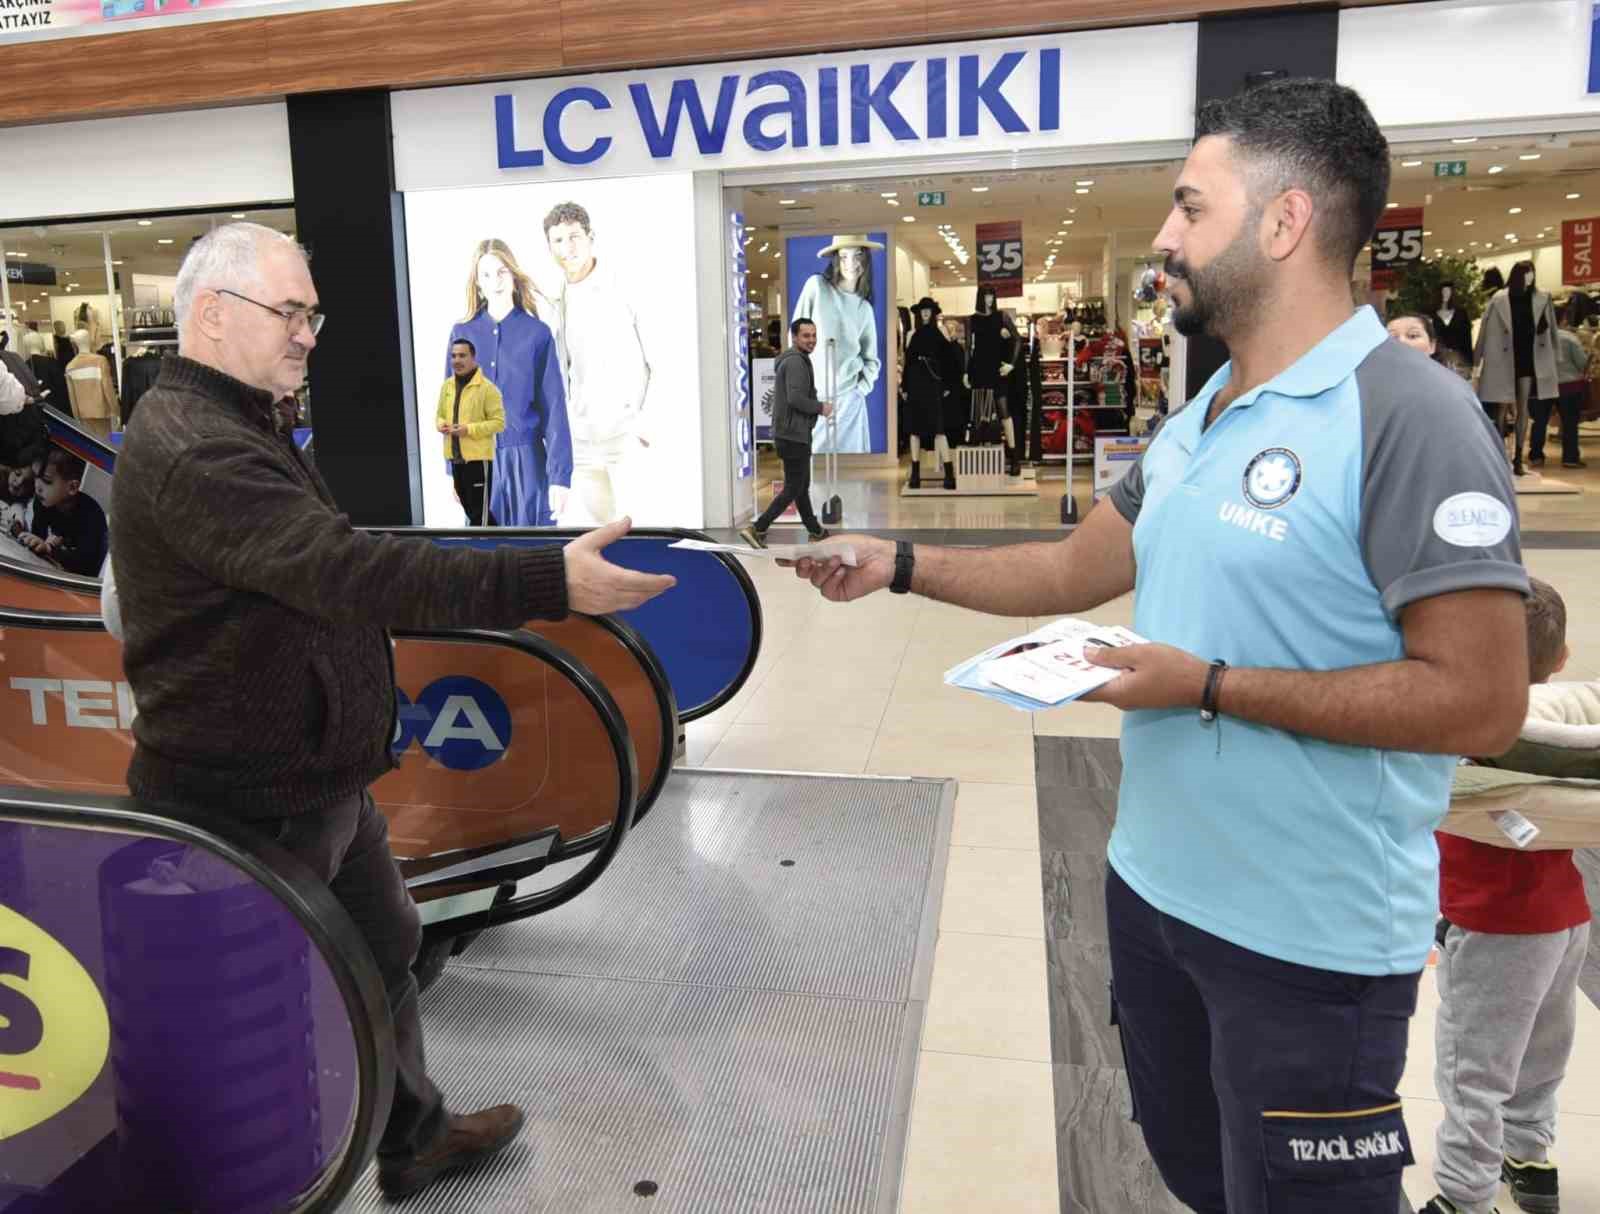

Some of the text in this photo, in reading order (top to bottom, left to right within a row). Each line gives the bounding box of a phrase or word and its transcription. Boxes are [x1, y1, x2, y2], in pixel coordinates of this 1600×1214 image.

[494, 86, 612, 169] LC
[1573, 221, 1593, 277] SALE
[1219, 501, 1288, 541] UMKE
[1288, 1131, 1404, 1161] 112 ACİL SAĞLIK
